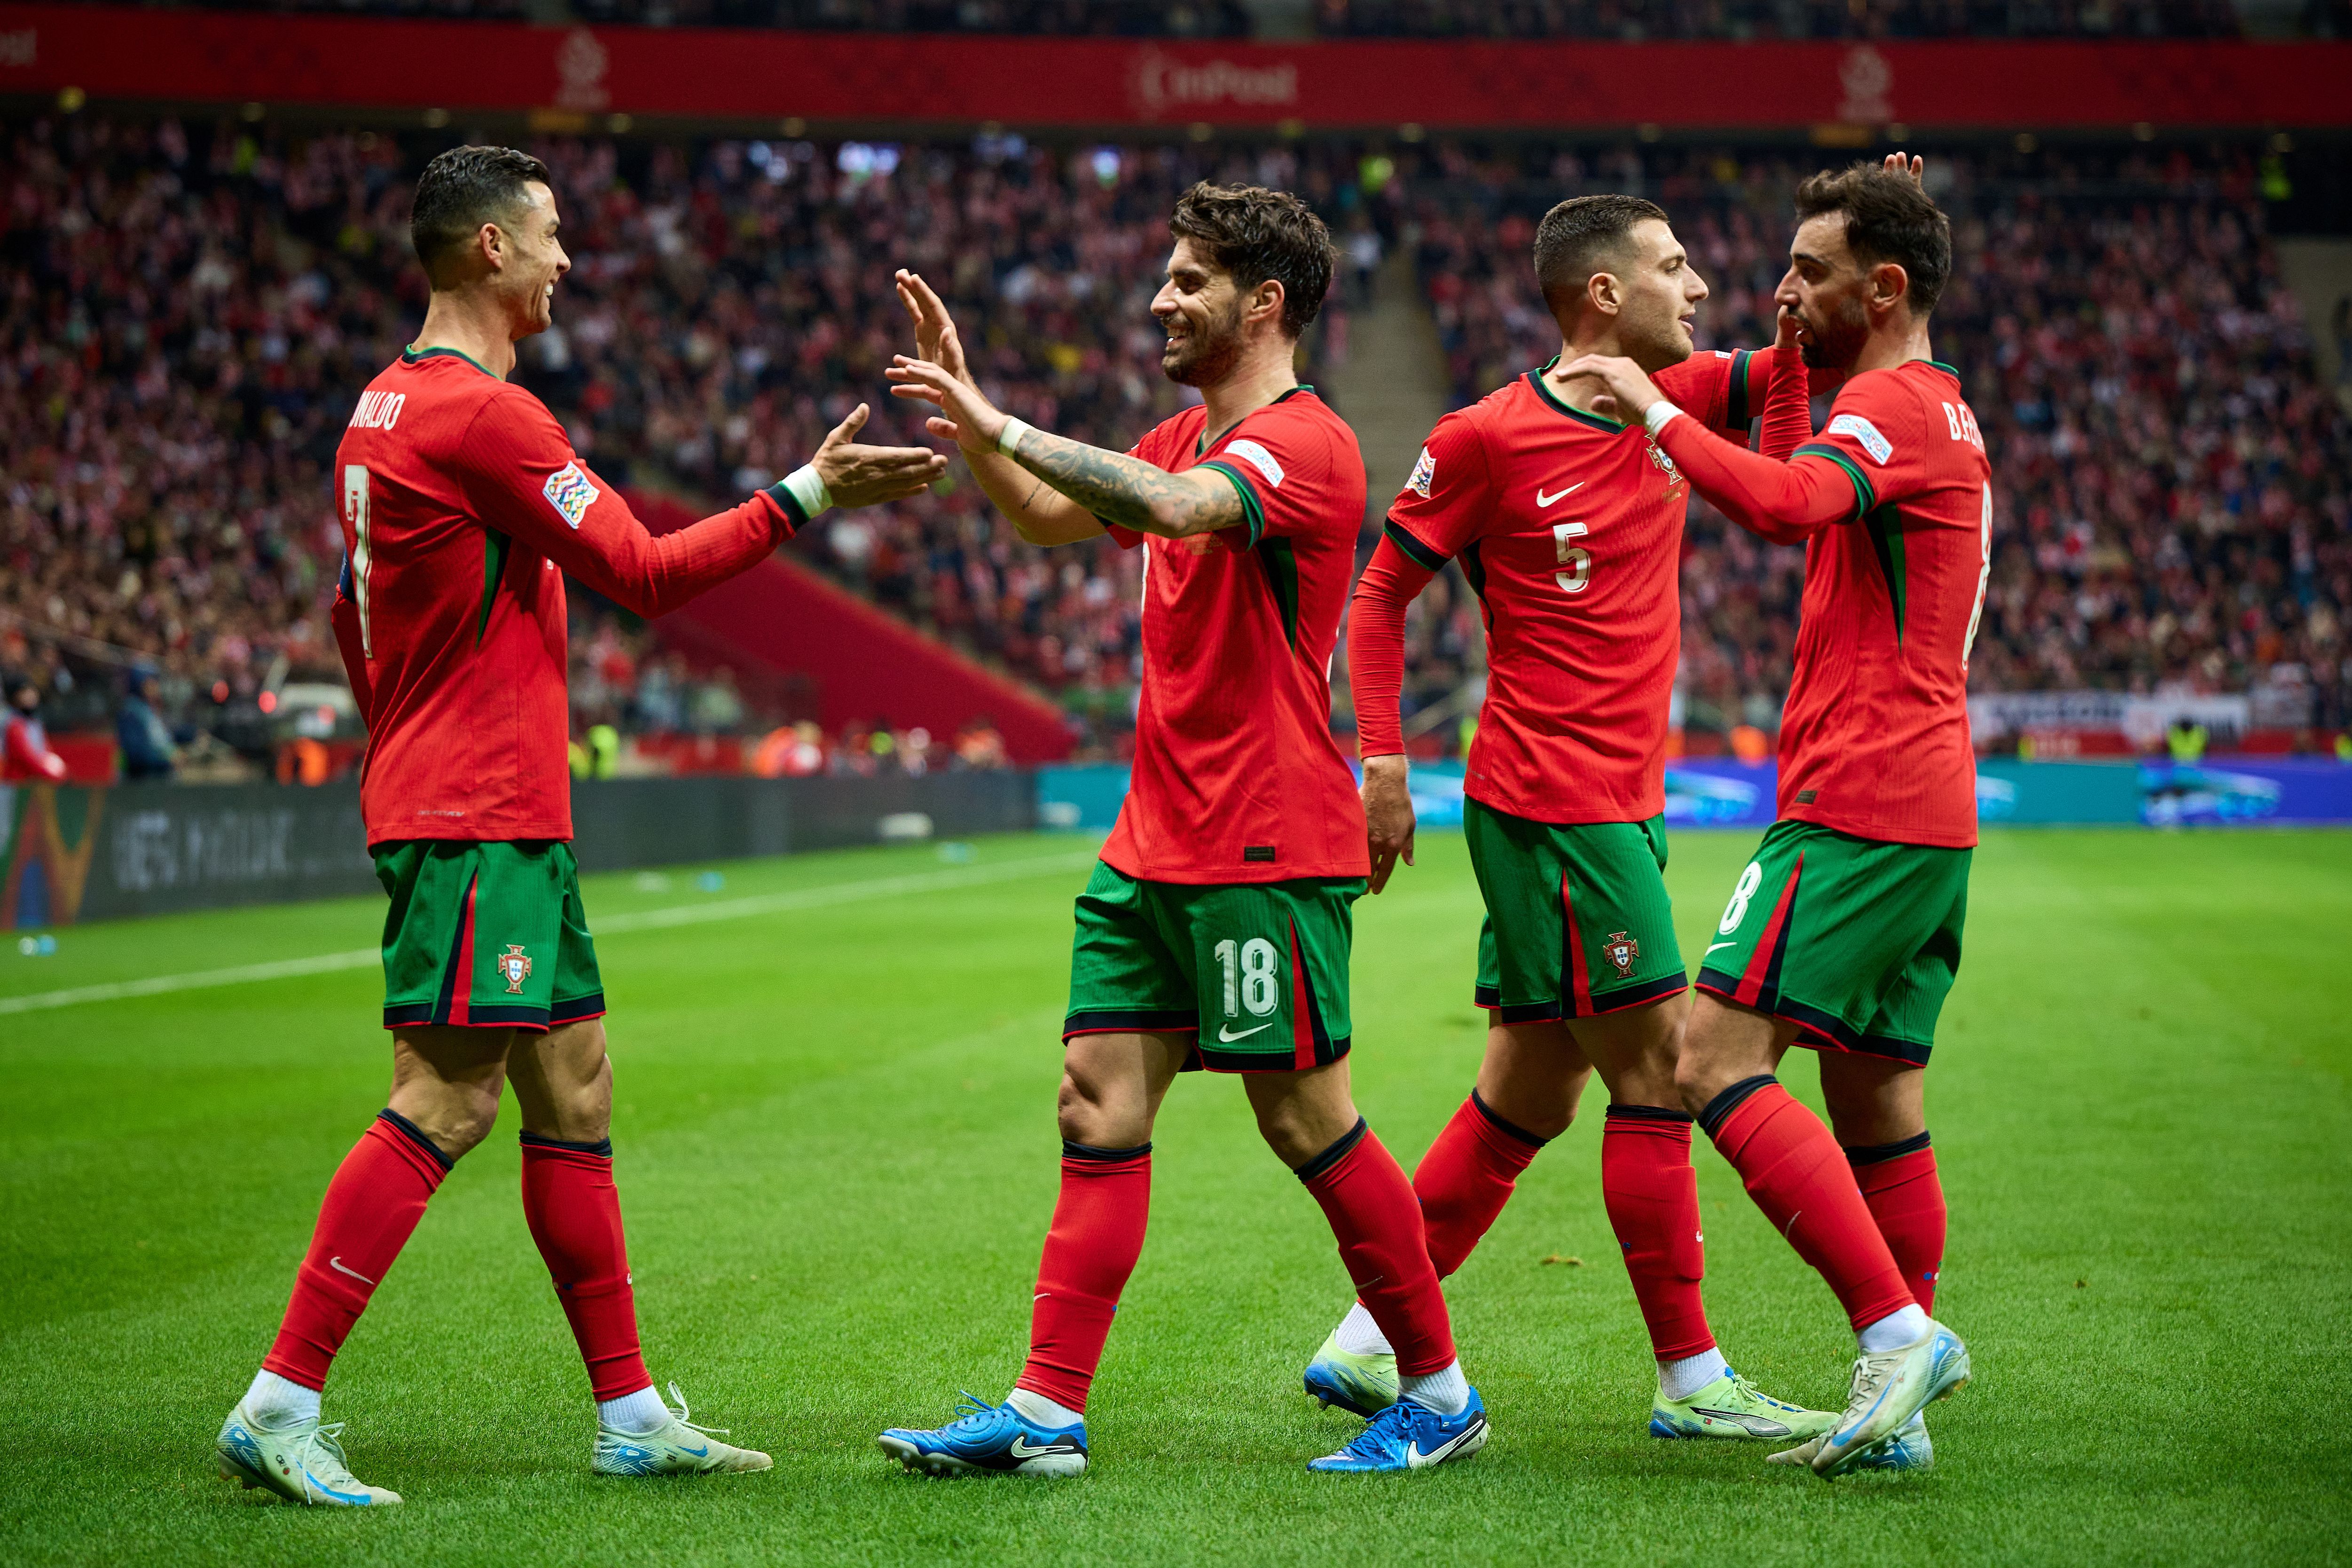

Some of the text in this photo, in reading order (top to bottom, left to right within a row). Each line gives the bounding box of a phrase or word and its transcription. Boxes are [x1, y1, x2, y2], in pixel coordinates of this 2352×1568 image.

[345, 464, 372, 659] 7
[1552, 522, 1591, 592] 5
[1718, 861, 1762, 935] 8
[1214, 938, 1279, 1018] 18
